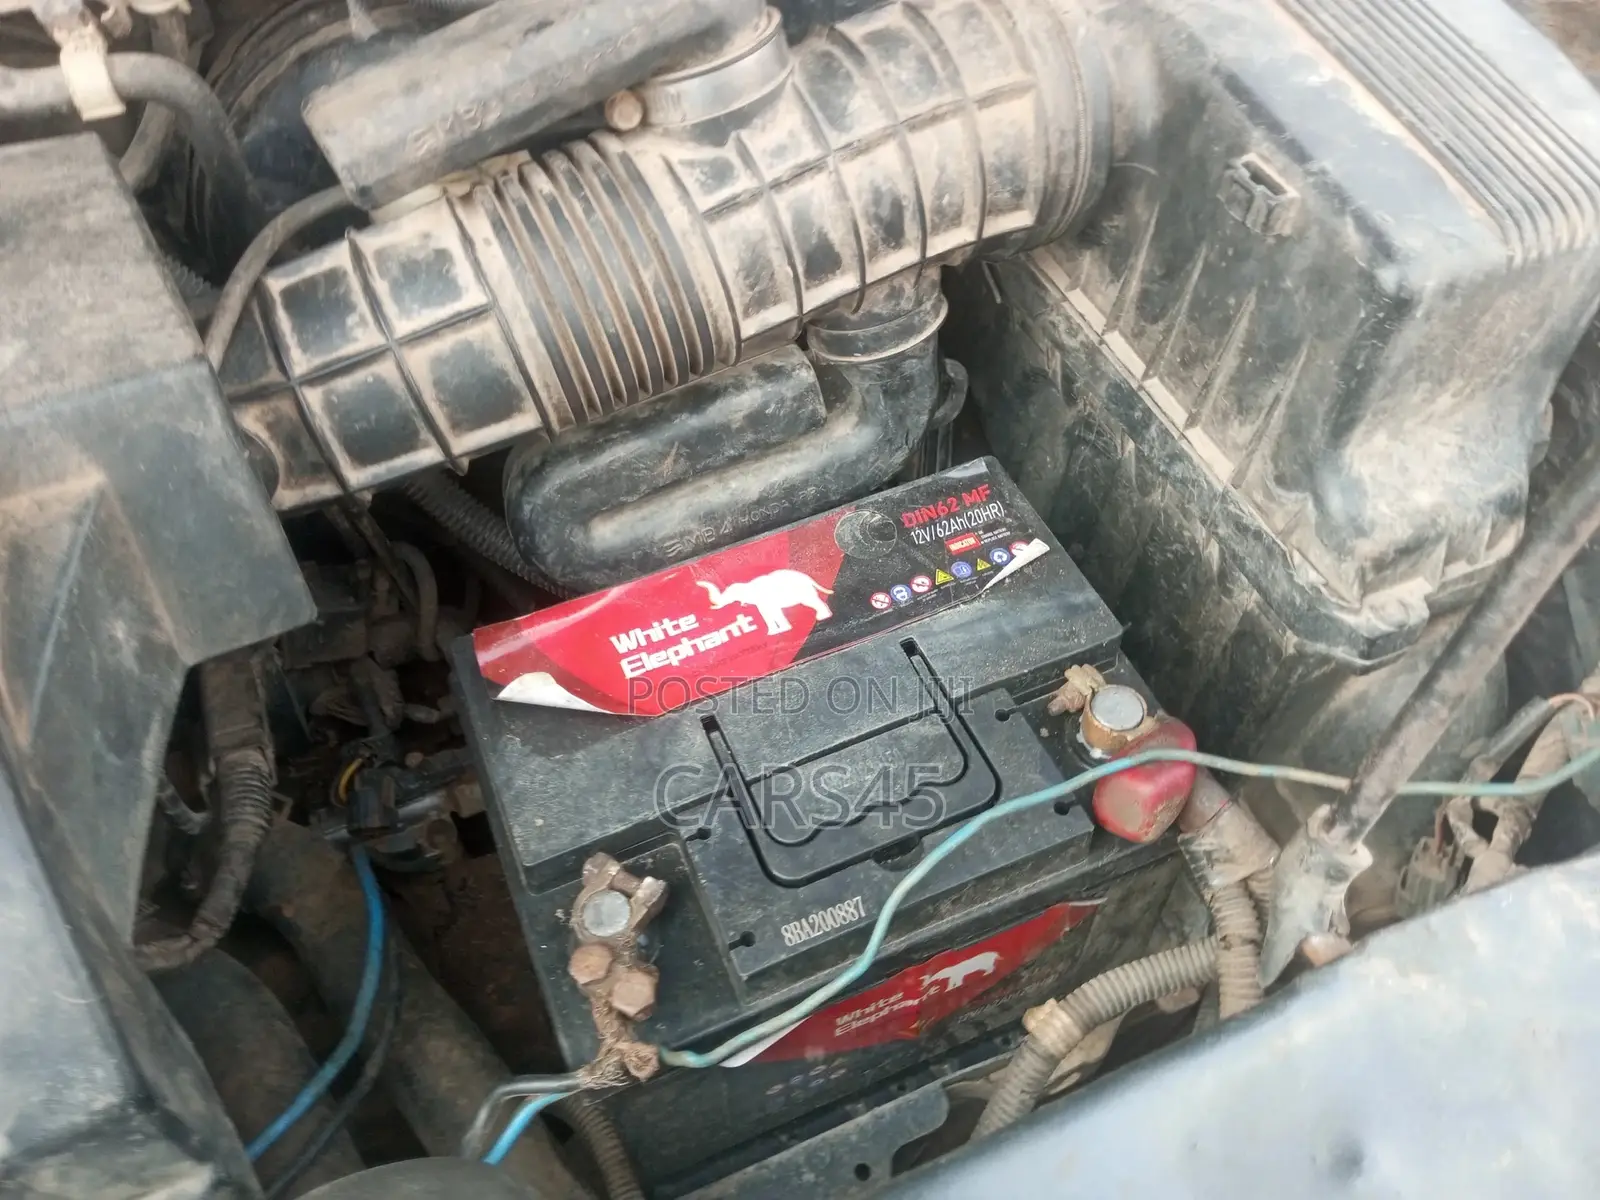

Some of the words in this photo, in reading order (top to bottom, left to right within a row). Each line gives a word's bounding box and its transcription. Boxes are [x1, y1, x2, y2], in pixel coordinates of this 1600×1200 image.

[902, 496, 960, 528] DIN62
[962, 484, 991, 507] MF
[609, 612, 700, 655] White
[619, 613, 758, 680] Elephant
[780, 895, 866, 947] 8BA200887
